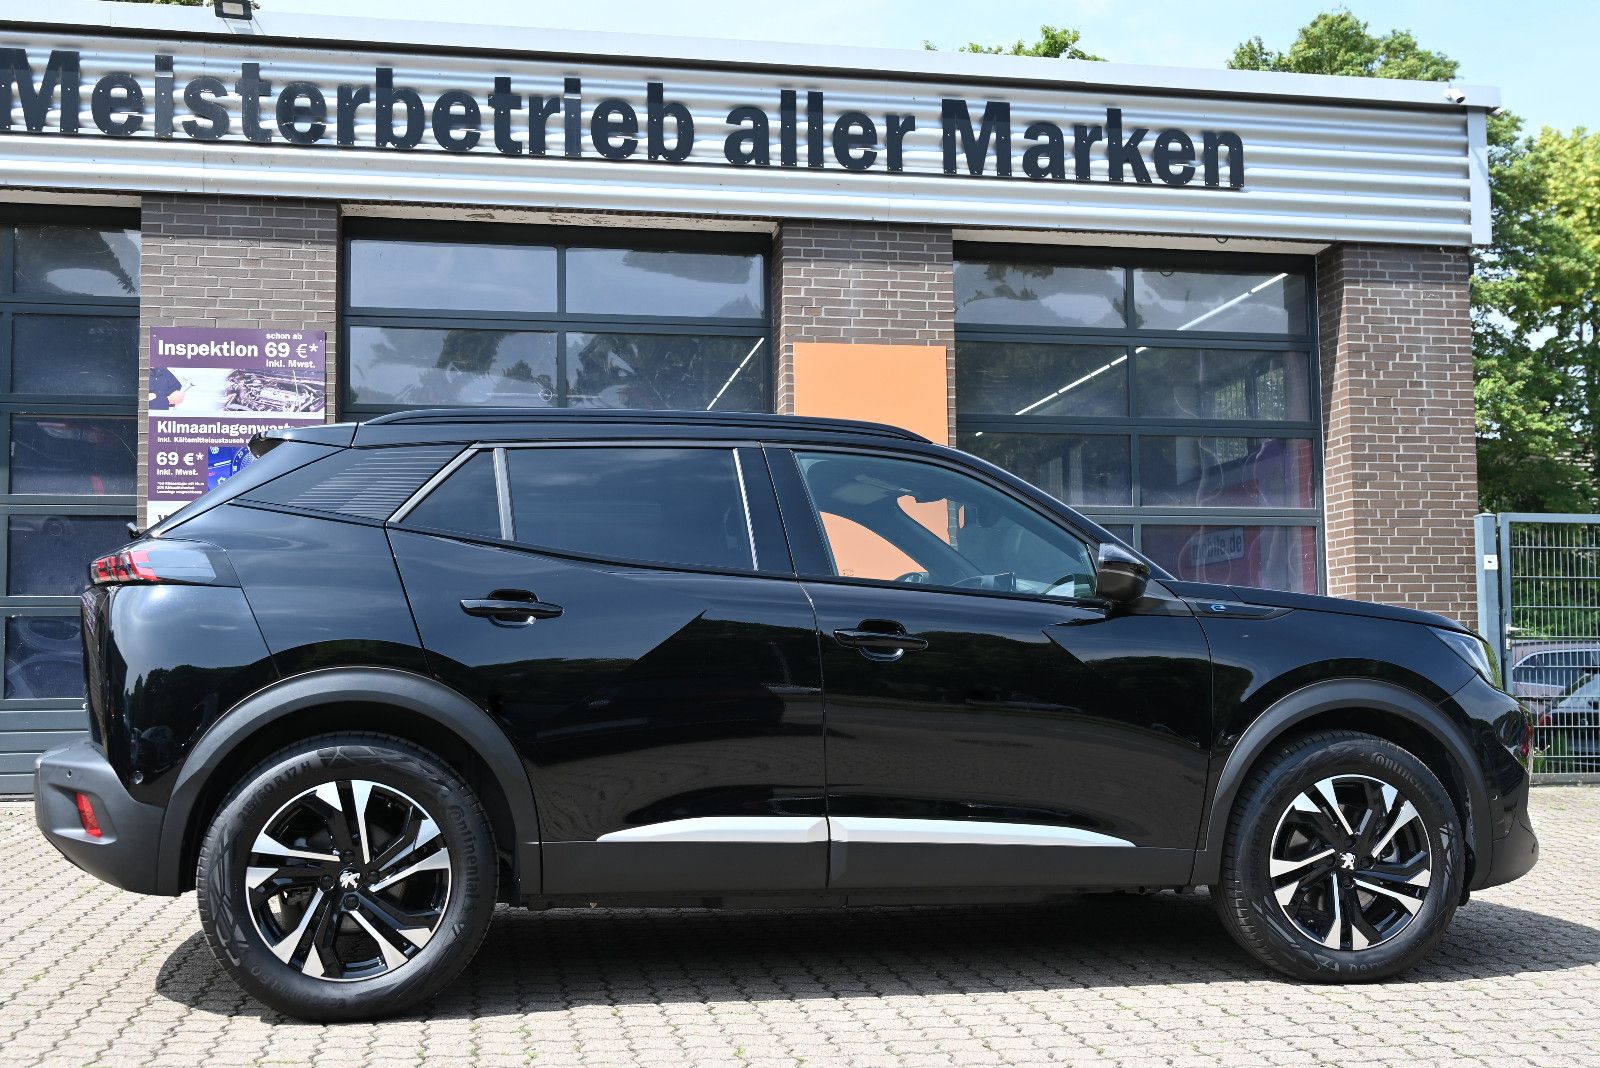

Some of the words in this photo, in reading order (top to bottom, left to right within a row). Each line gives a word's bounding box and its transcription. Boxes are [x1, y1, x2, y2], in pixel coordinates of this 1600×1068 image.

[0, 47, 694, 163] Meisterbetrieb
[723, 88, 915, 172] aller
[941, 98, 1245, 189] Marken
[158, 339, 259, 359] Inspektion
[264, 342, 290, 358] 69
[288, 360, 316, 369] Mwst.
[156, 451, 179, 466] 69
[175, 468, 199, 476] Mwst.
[1192, 531, 1242, 560] mobile.de
